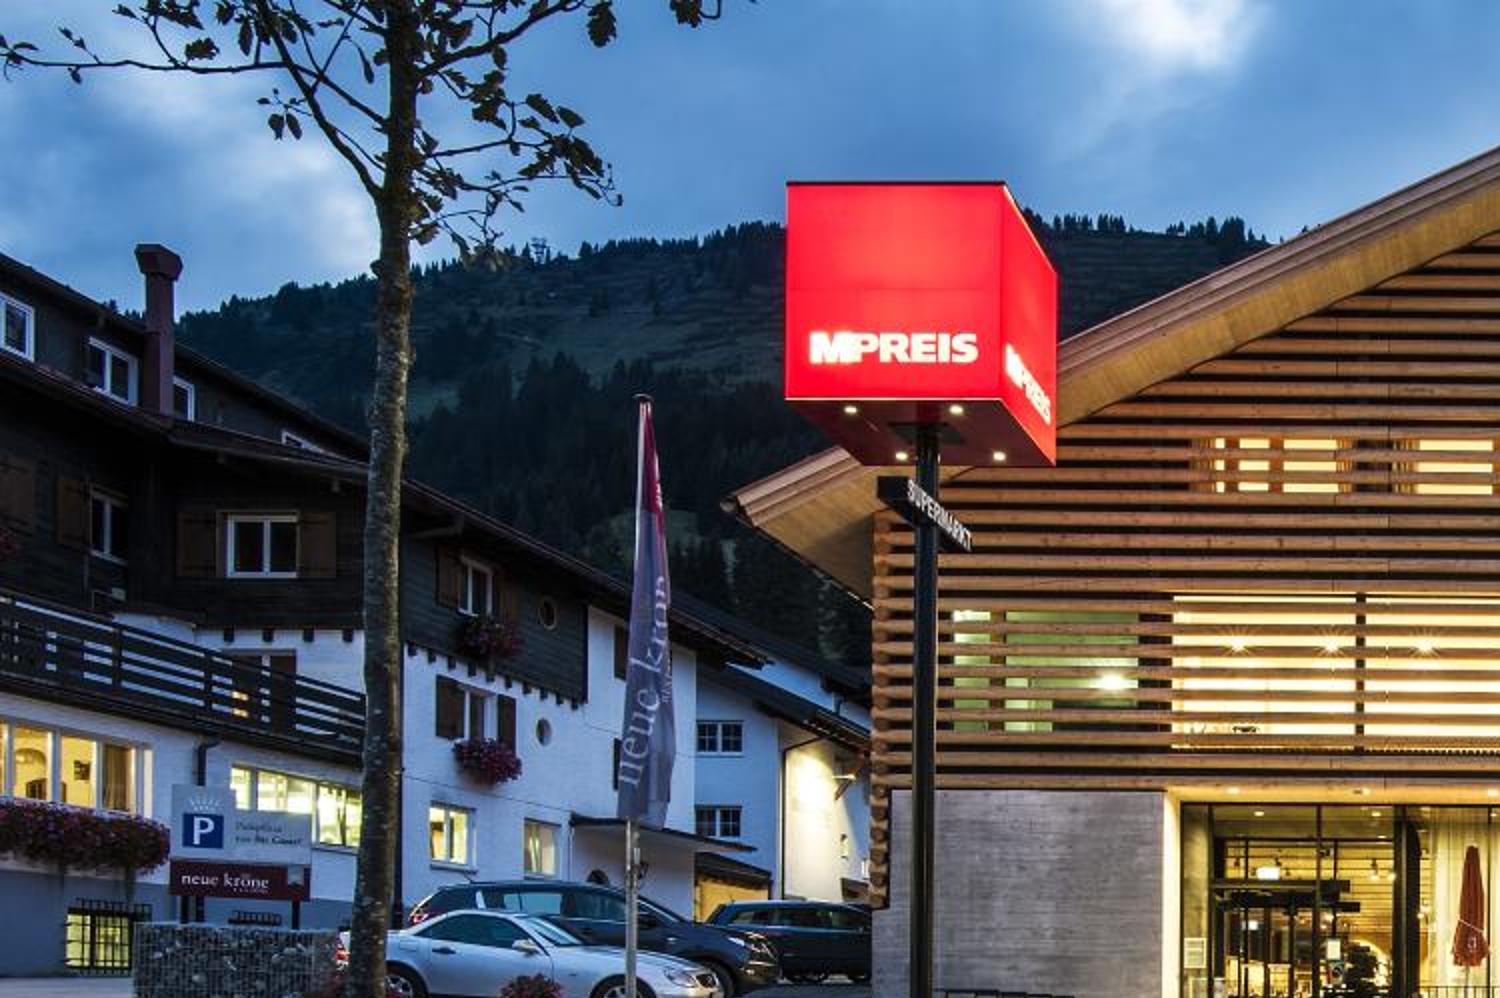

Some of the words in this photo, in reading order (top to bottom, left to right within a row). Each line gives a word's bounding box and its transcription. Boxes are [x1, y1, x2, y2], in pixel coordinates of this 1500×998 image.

[809, 332, 979, 365] MPREIS
[907, 479, 972, 552] SUPERMARKT
[628, 575, 669, 674] kron
[192, 815, 215, 846] P
[181, 873, 219, 886] neue
